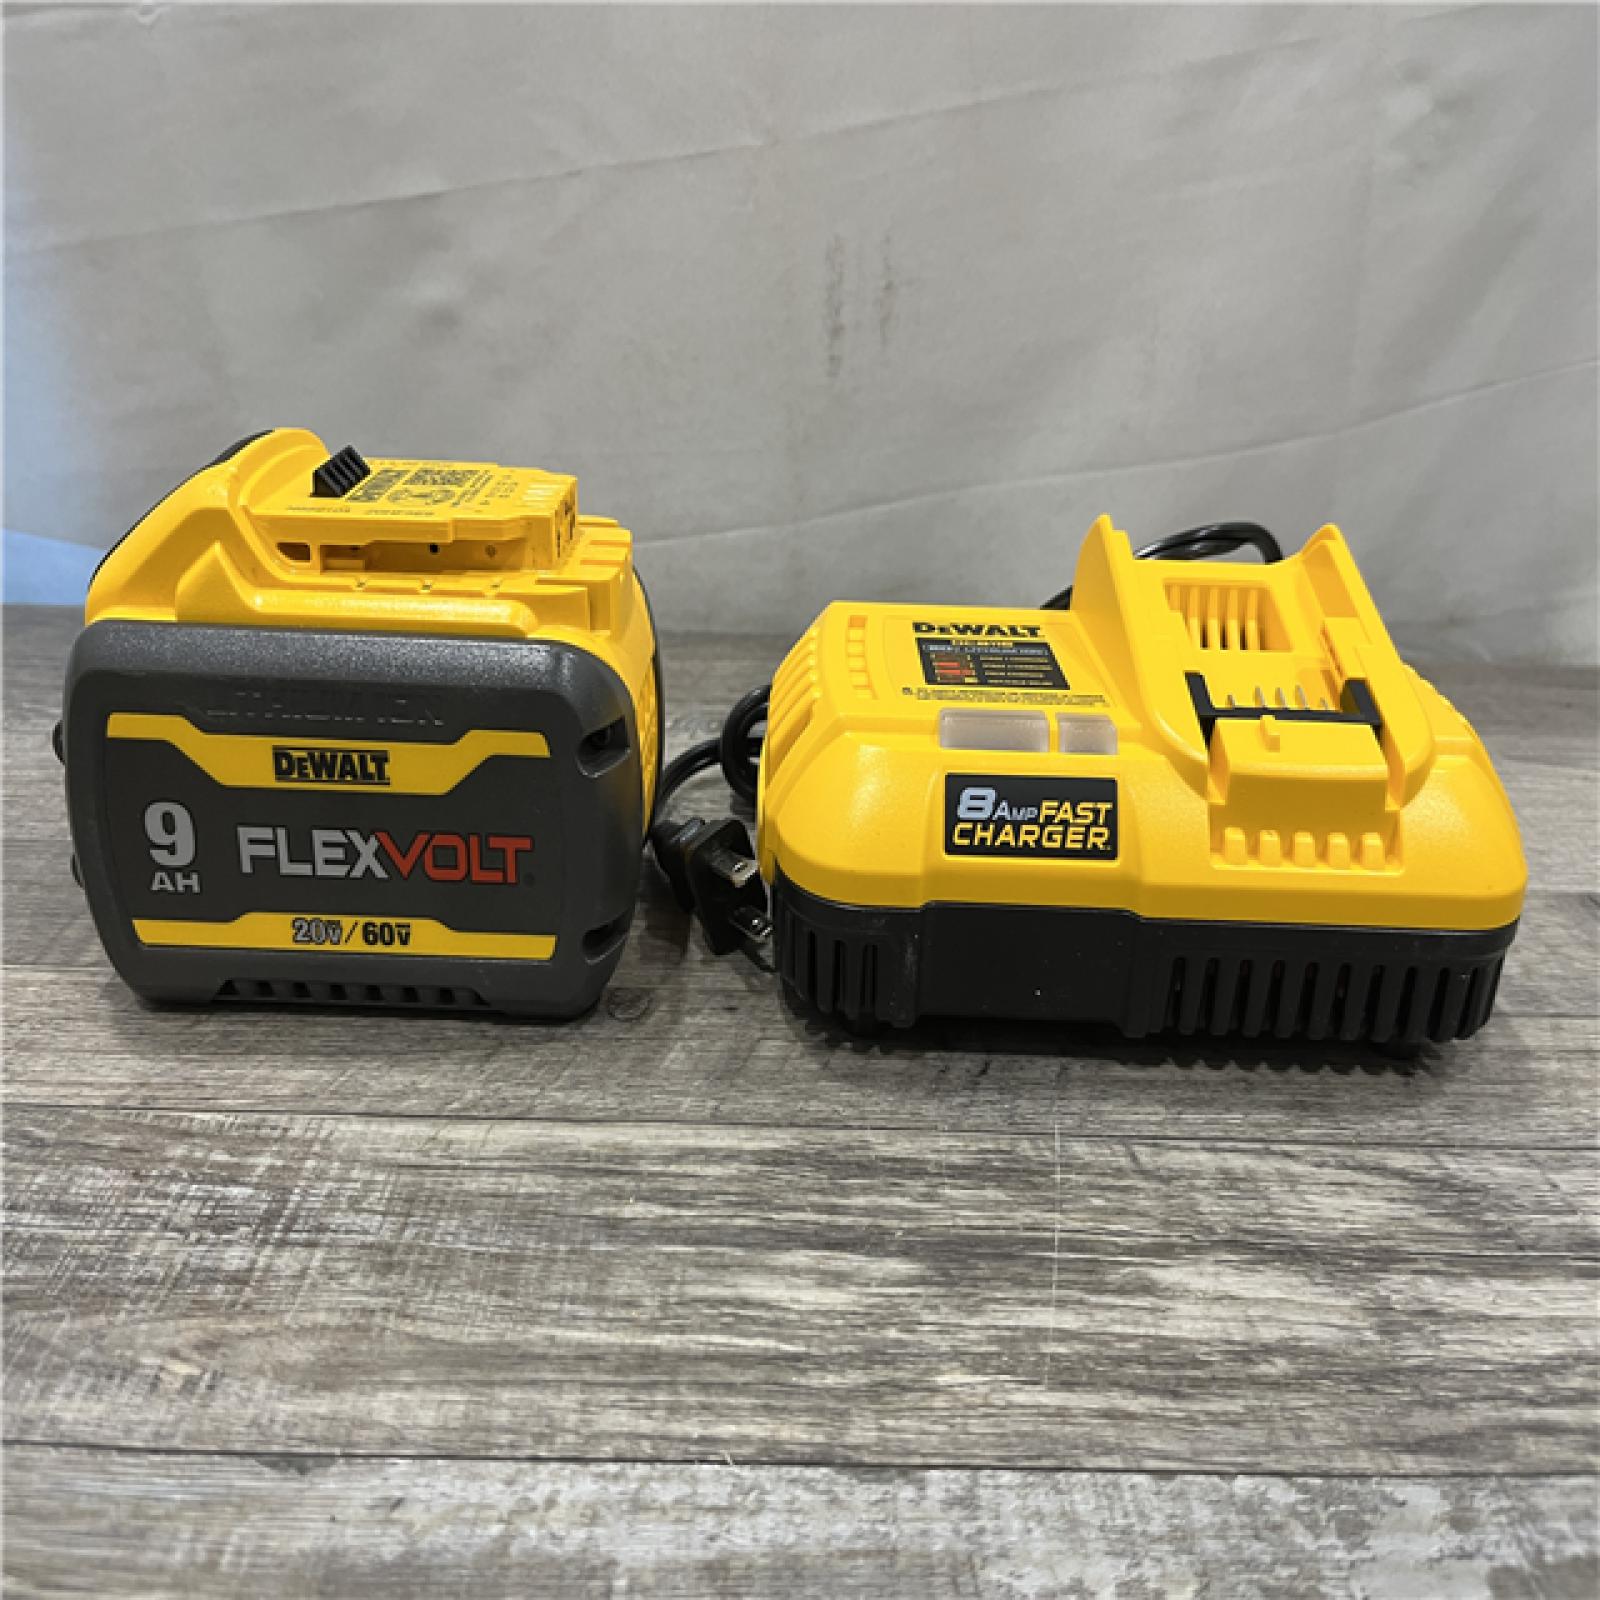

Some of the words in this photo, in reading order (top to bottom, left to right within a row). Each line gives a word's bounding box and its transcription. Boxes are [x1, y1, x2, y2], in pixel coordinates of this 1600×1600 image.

[273, 747, 391, 784] DEWALT
[956, 786, 996, 821] 8
[1039, 800, 1114, 826] FAST
[143, 801, 197, 867] 9
[952, 822, 1111, 851] CHARGER
[236, 825, 533, 885] FLEXVOLT
[150, 871, 201, 894] AH
